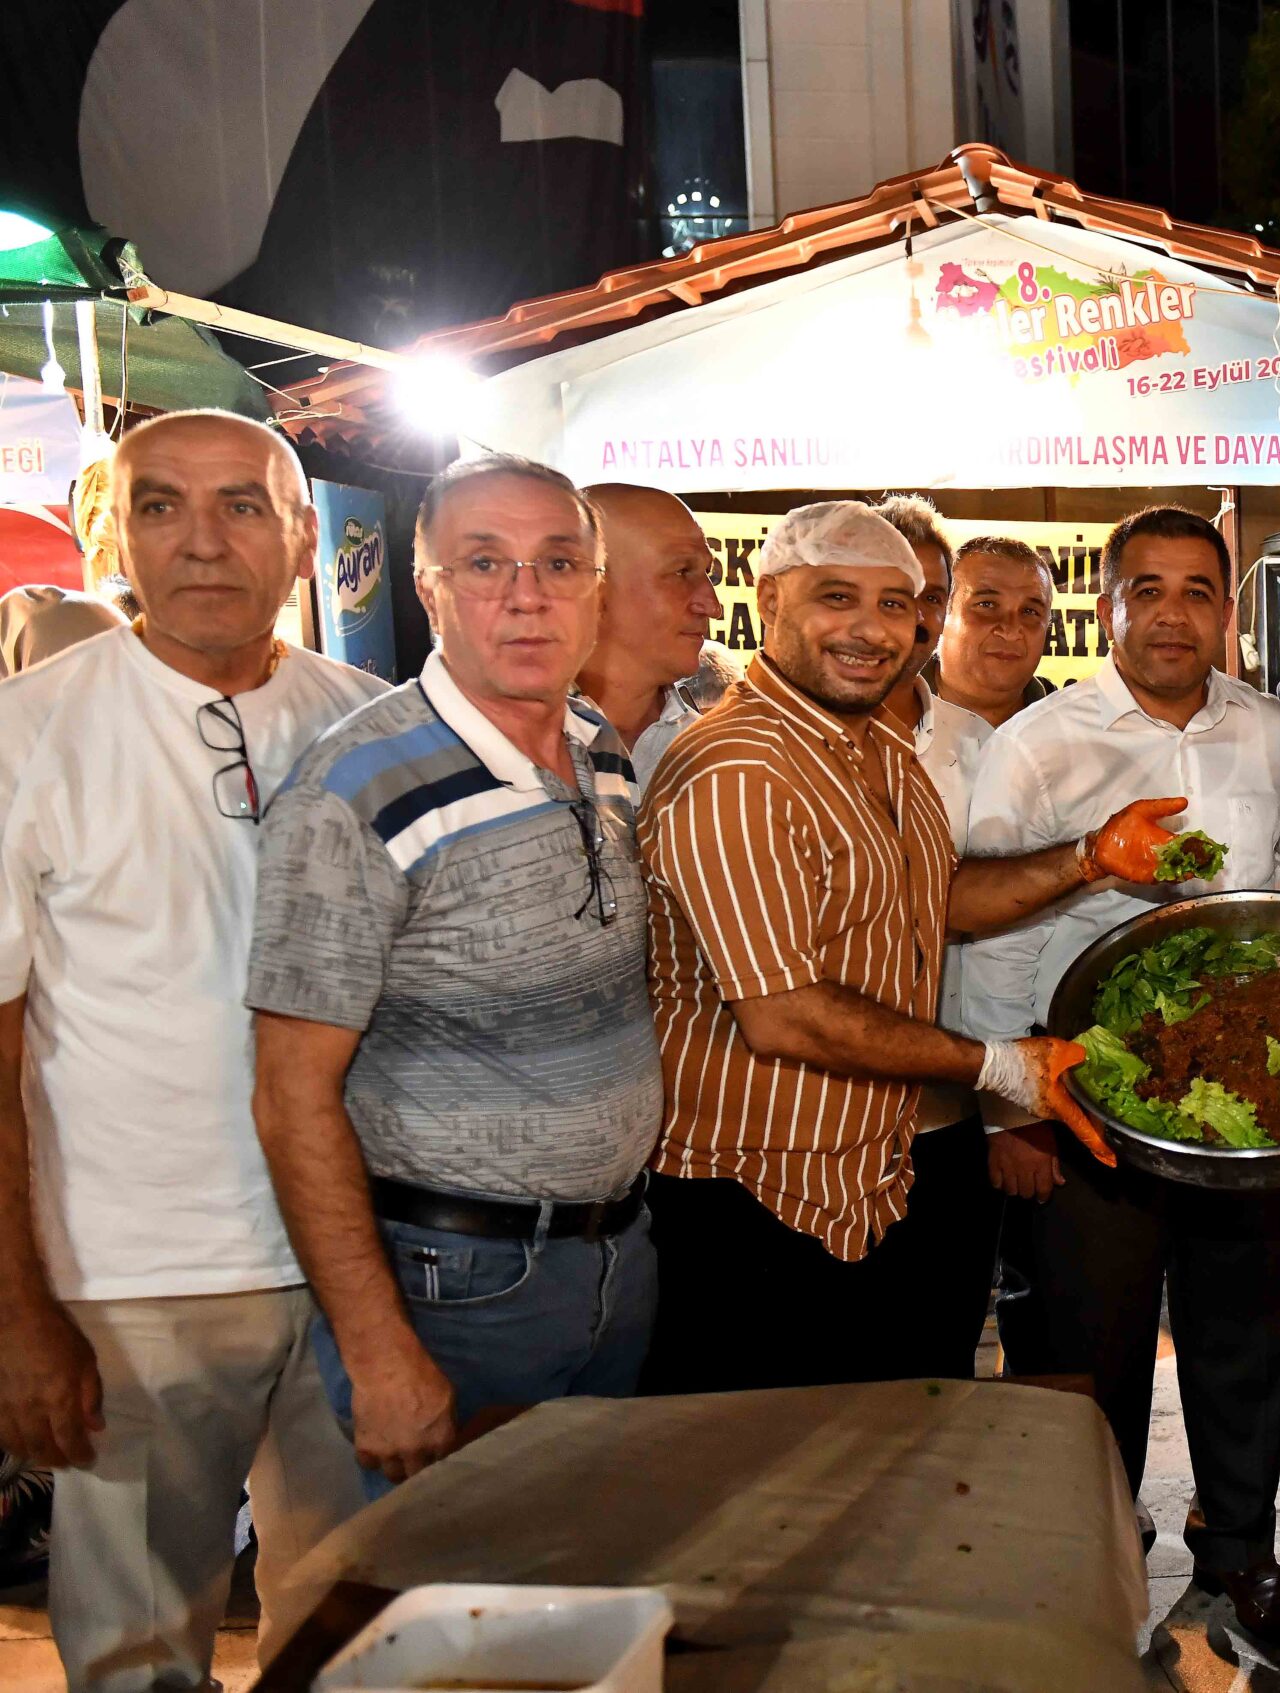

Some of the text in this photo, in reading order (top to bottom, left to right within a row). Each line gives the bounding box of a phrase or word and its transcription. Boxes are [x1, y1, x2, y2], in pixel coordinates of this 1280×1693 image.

[1018, 261, 1051, 303] 8.
[1056, 275, 1198, 338] Renkler
[1004, 336, 1120, 379] estivali
[1126, 371, 1186, 397] 16-22
[1194, 361, 1251, 391] Eylül
[602, 439, 725, 470] ANTALYA
[1176, 435, 1208, 465] VE
[337, 535, 381, 595] Ayran
